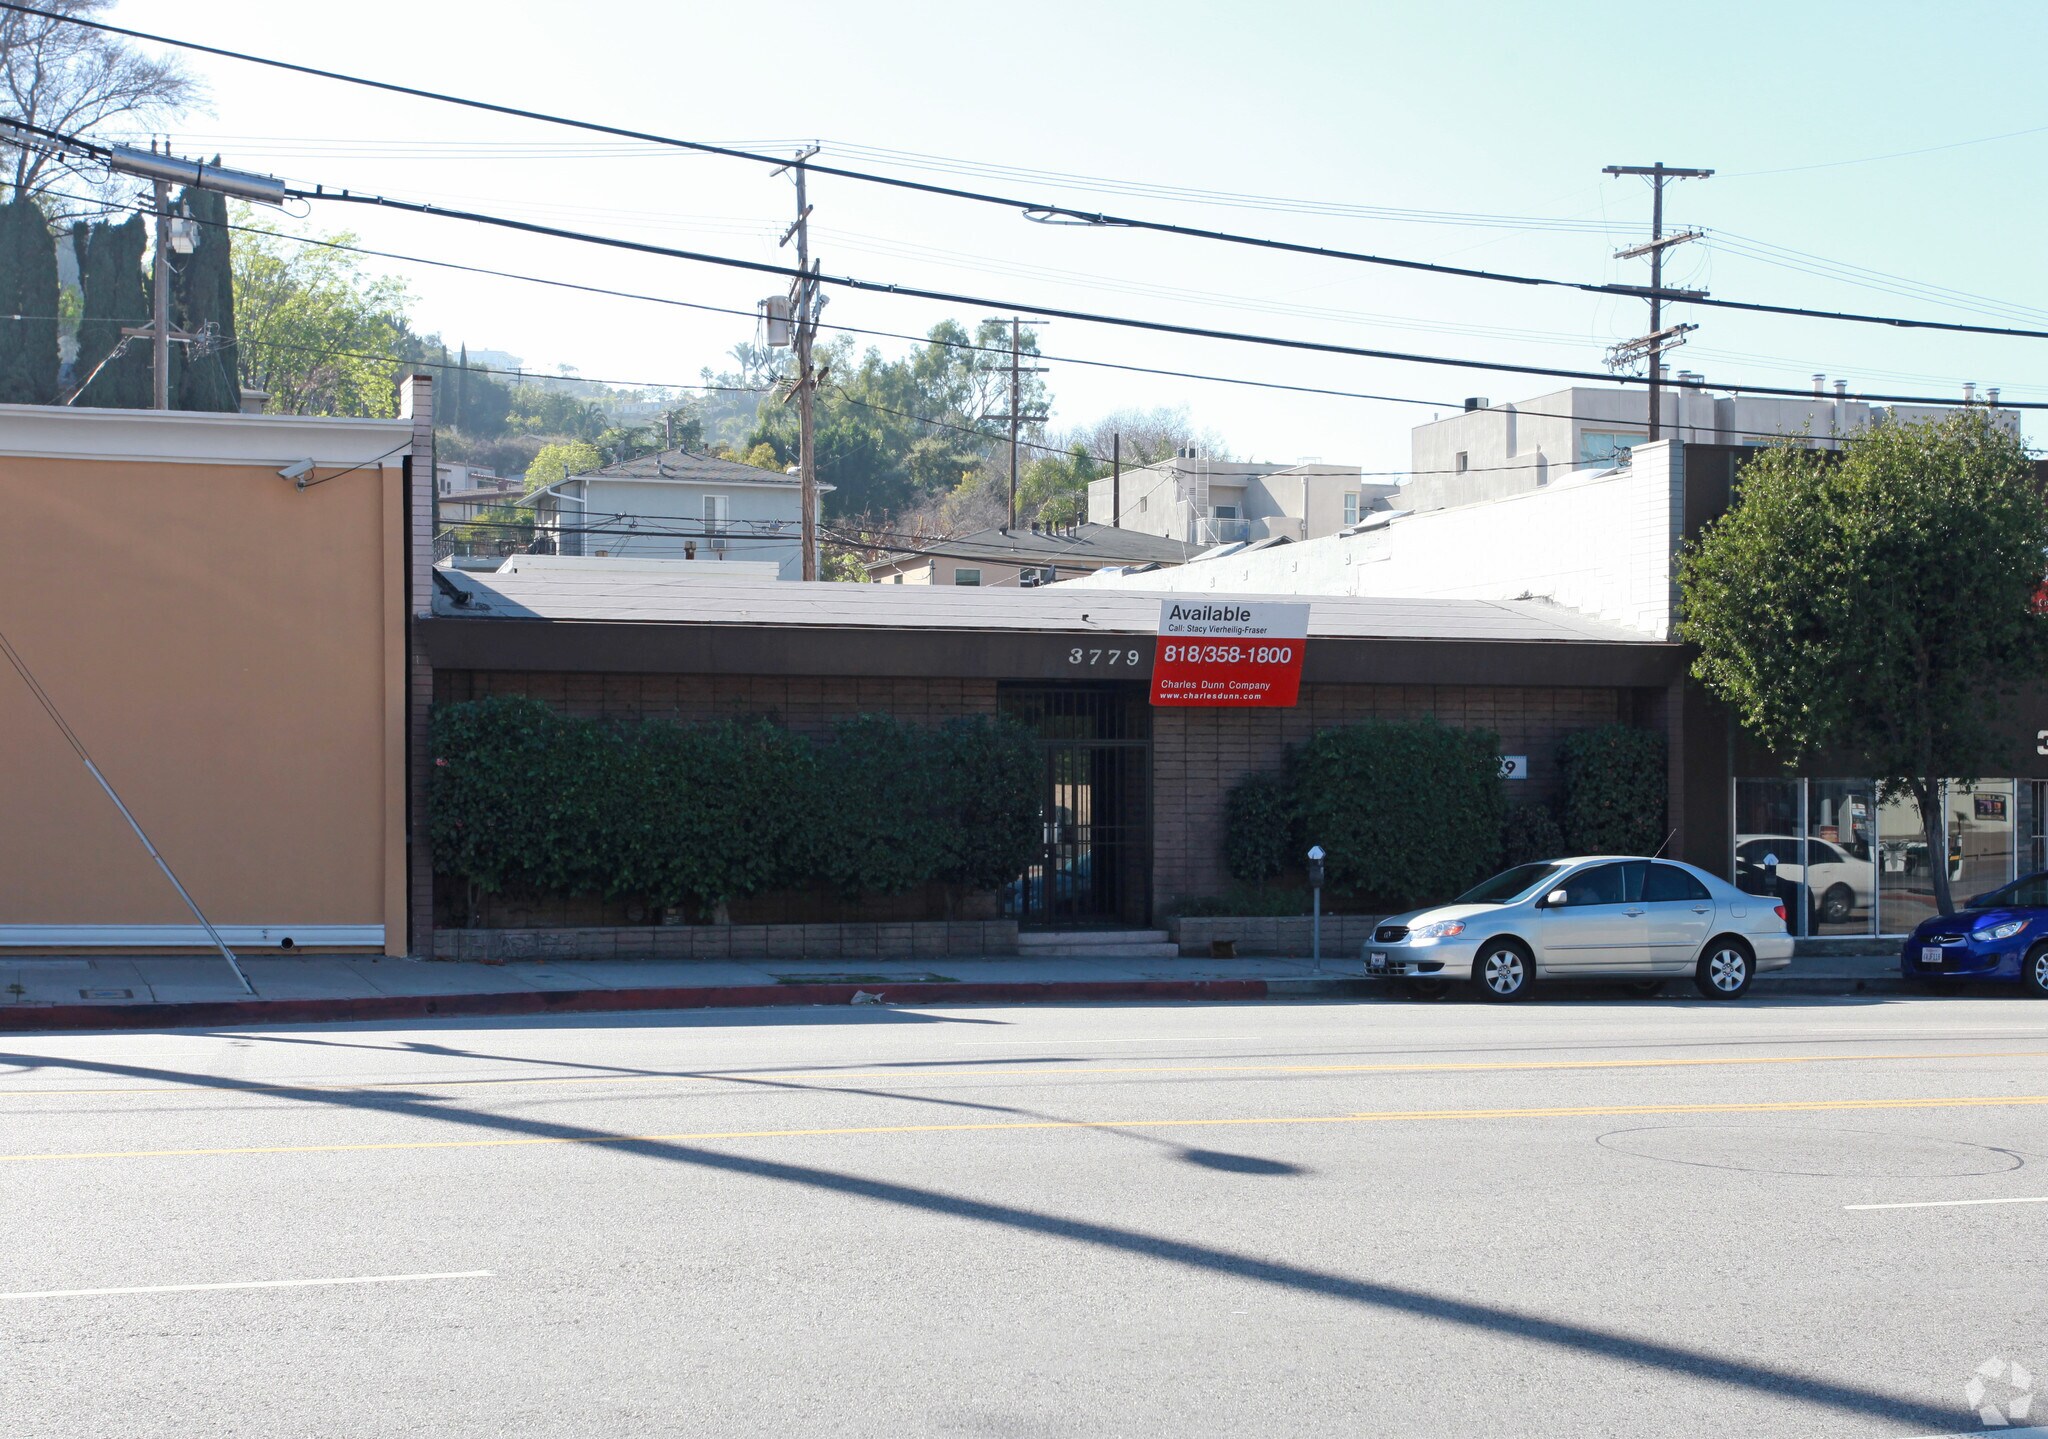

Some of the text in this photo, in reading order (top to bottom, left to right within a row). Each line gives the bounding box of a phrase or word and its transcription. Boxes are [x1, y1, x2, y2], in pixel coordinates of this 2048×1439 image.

[1169, 604, 1251, 622] Available
[1168, 624, 1268, 635] Call: Stacy Vierheilig-Fraser
[1068, 647, 1139, 666] 3779
[1164, 645, 1292, 664] 818/358-1800
[1161, 680, 1271, 690] Charles Dunn Company
[1159, 692, 1262, 700] www.charlesdunn.com
